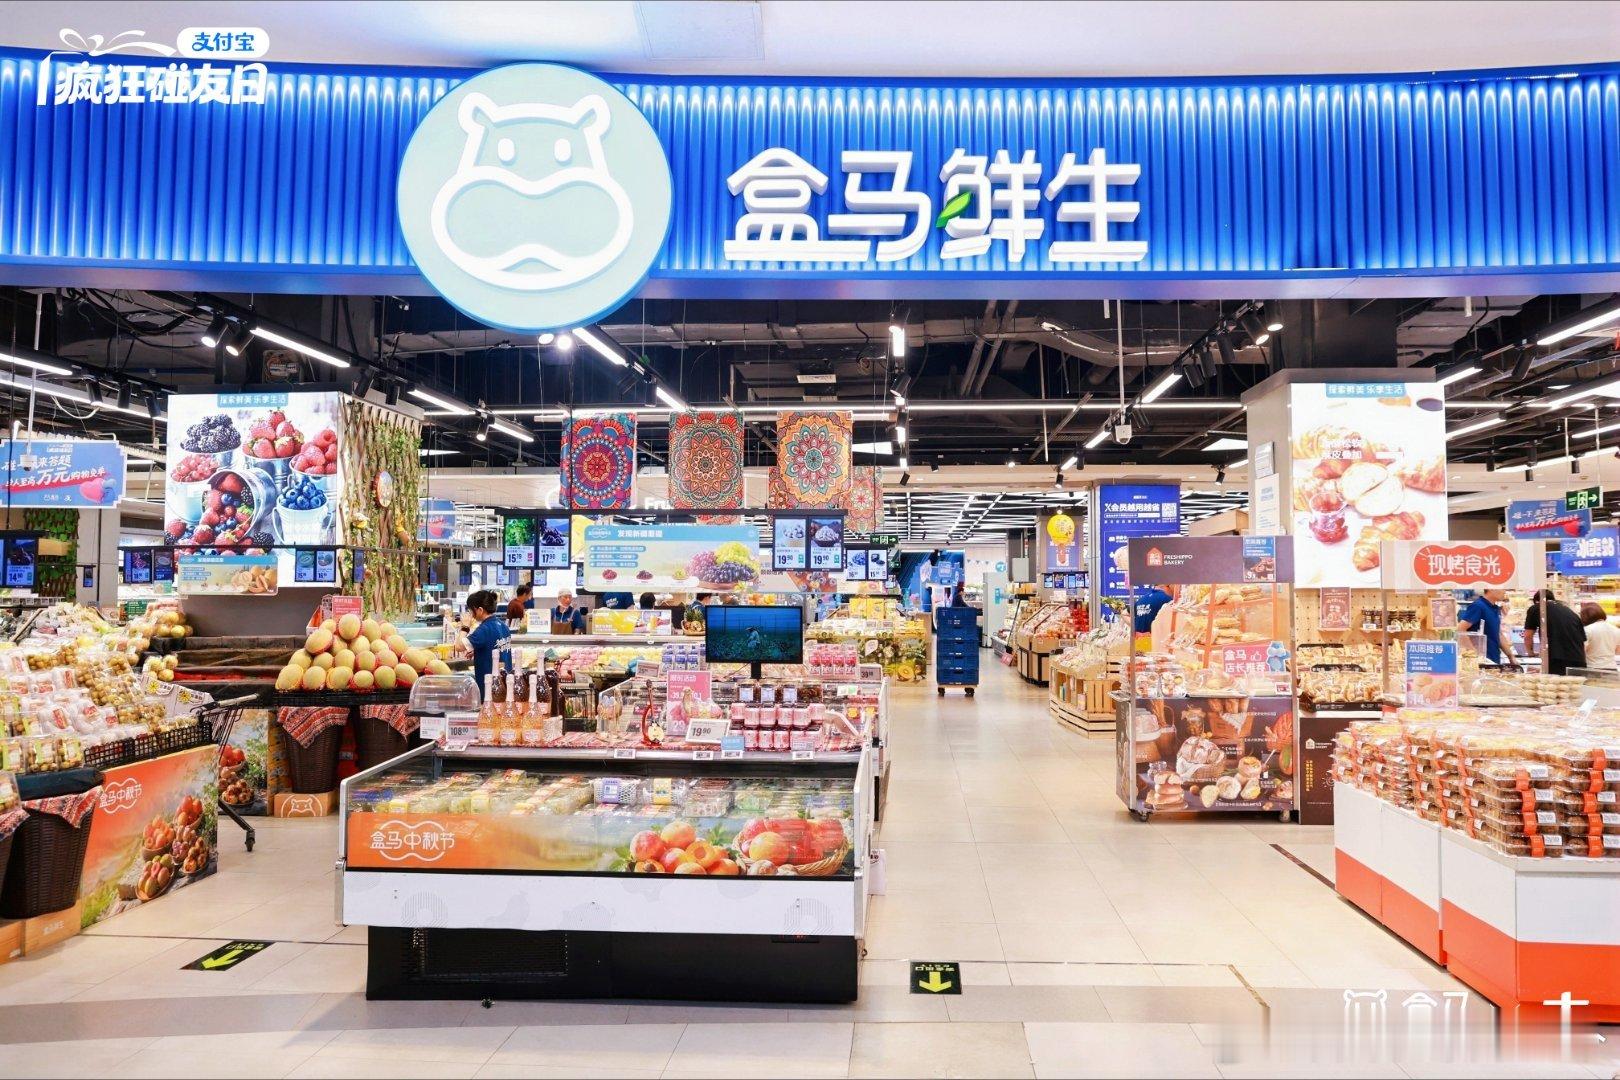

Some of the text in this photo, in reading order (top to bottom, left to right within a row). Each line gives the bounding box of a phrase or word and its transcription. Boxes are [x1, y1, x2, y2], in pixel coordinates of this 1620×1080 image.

[723, 147, 1148, 262] 盒马鲜生
[1428, 554, 1501, 576] 现烤食光
[1225, 650, 1247, 661] 盒马
[98, 783, 143, 808] 盒马中秋节
[370, 831, 456, 850] 盒马中秋节
